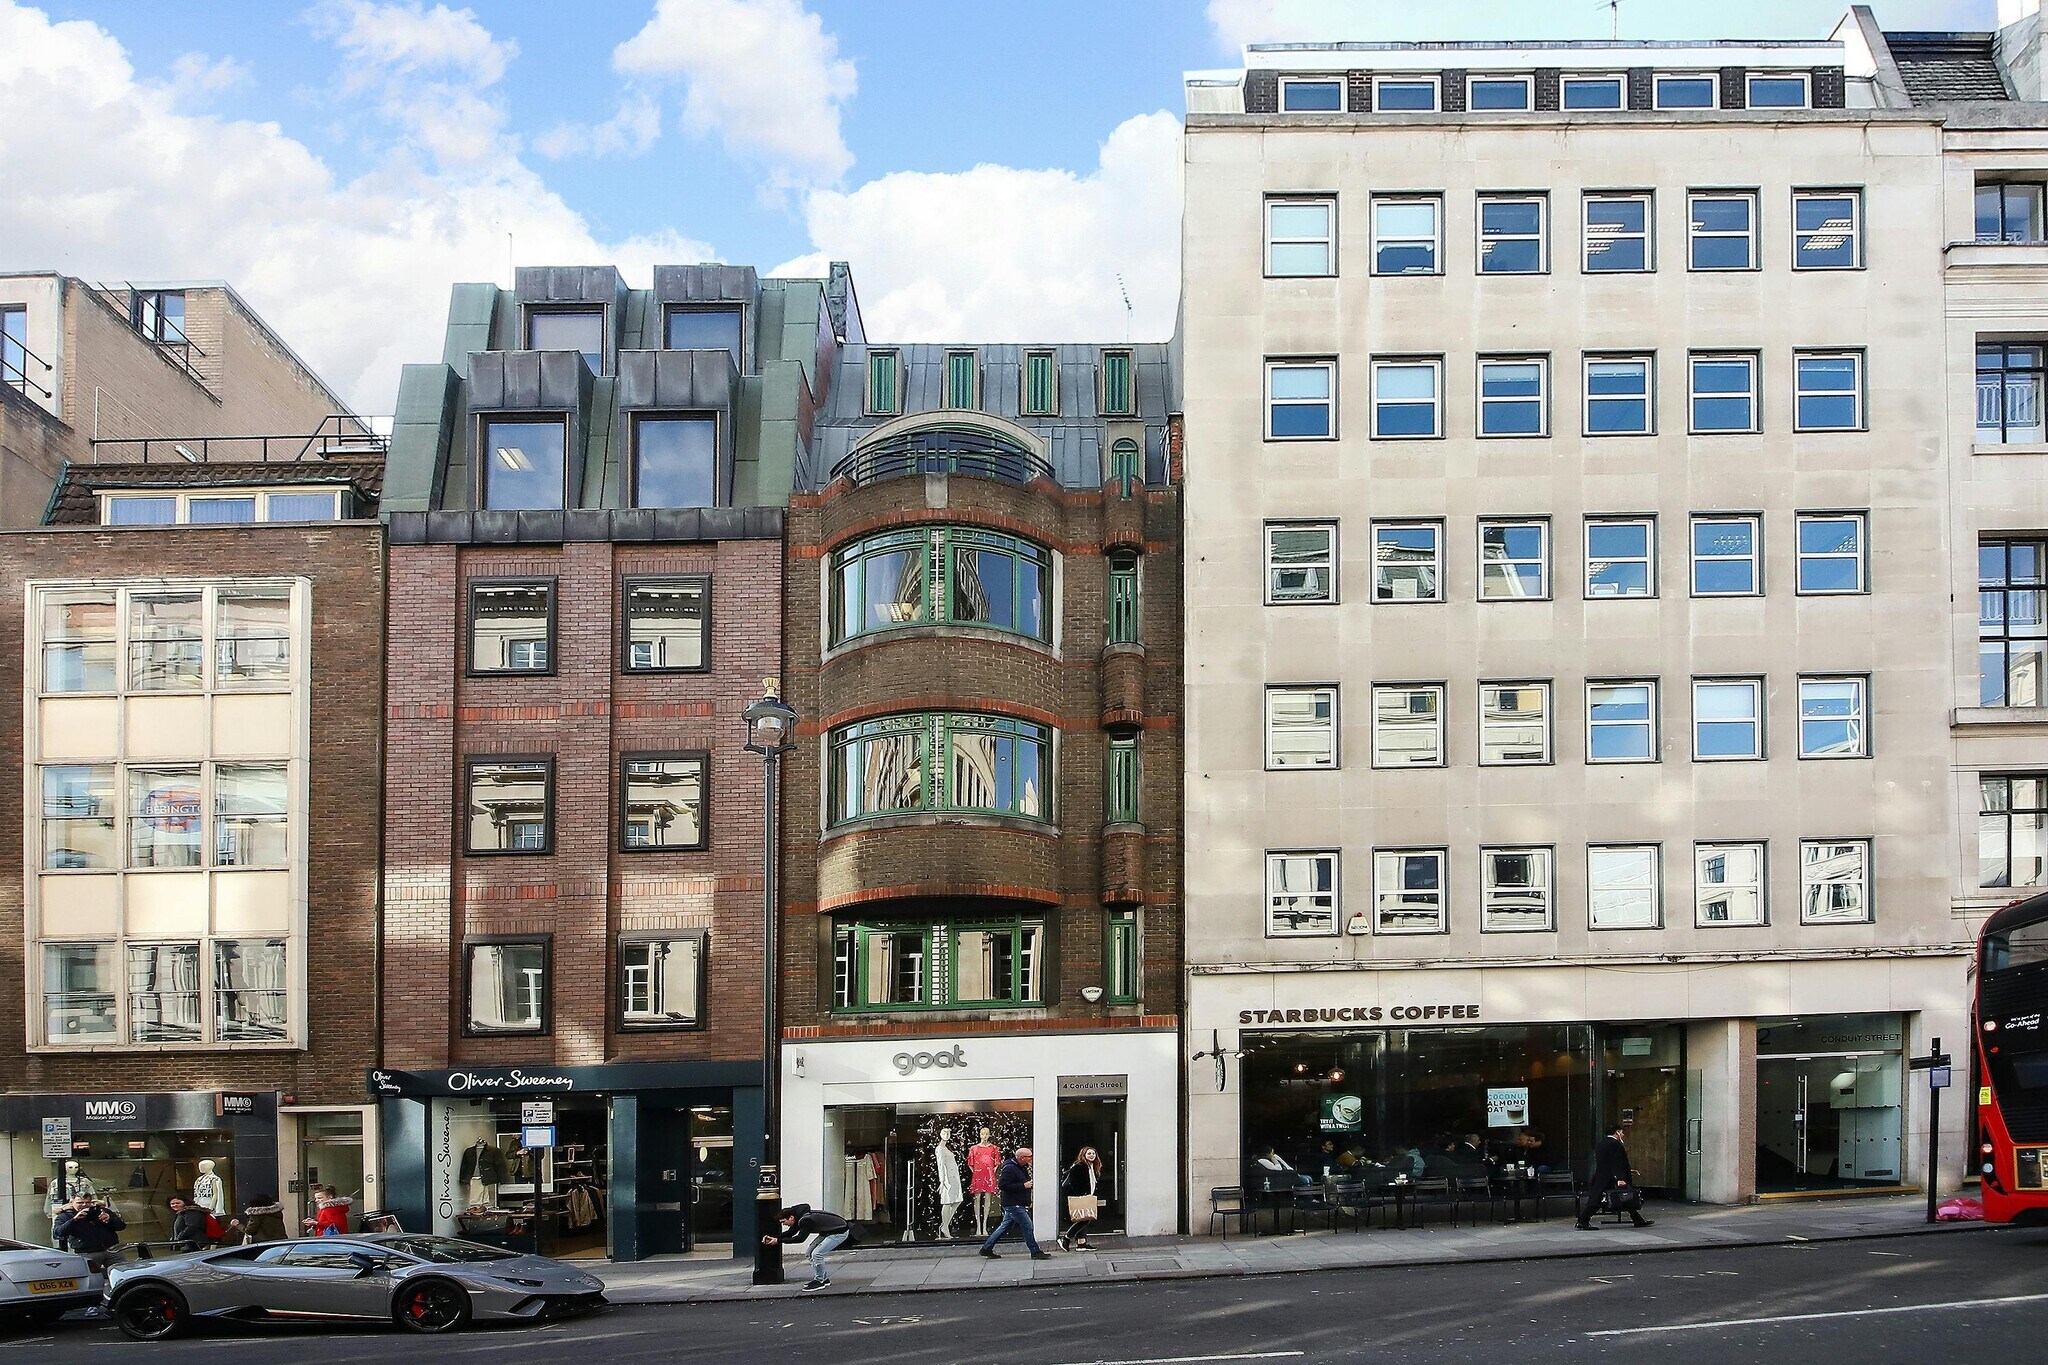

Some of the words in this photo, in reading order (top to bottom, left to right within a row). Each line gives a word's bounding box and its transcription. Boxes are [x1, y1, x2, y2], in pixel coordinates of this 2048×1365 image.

[1239, 1006, 1383, 1024] STARBUCKS
[1390, 1005, 1480, 1020] COFFEE
[2005, 1018, 2040, 1029] Go-Ahead
[1821, 1034, 1863, 1043] CONDUIT
[1865, 1033, 1901, 1042] STREET
[892, 1044, 968, 1076] goat
[448, 1072, 504, 1091] Oliver
[504, 1069, 574, 1090] Sweeney
[85, 1101, 136, 1115] MM6
[437, 1106, 455, 1167] Sweeney
[749, 1157, 757, 1167] 5
[365, 1174, 374, 1183] 6
[439, 1169, 453, 1219] Oliver
